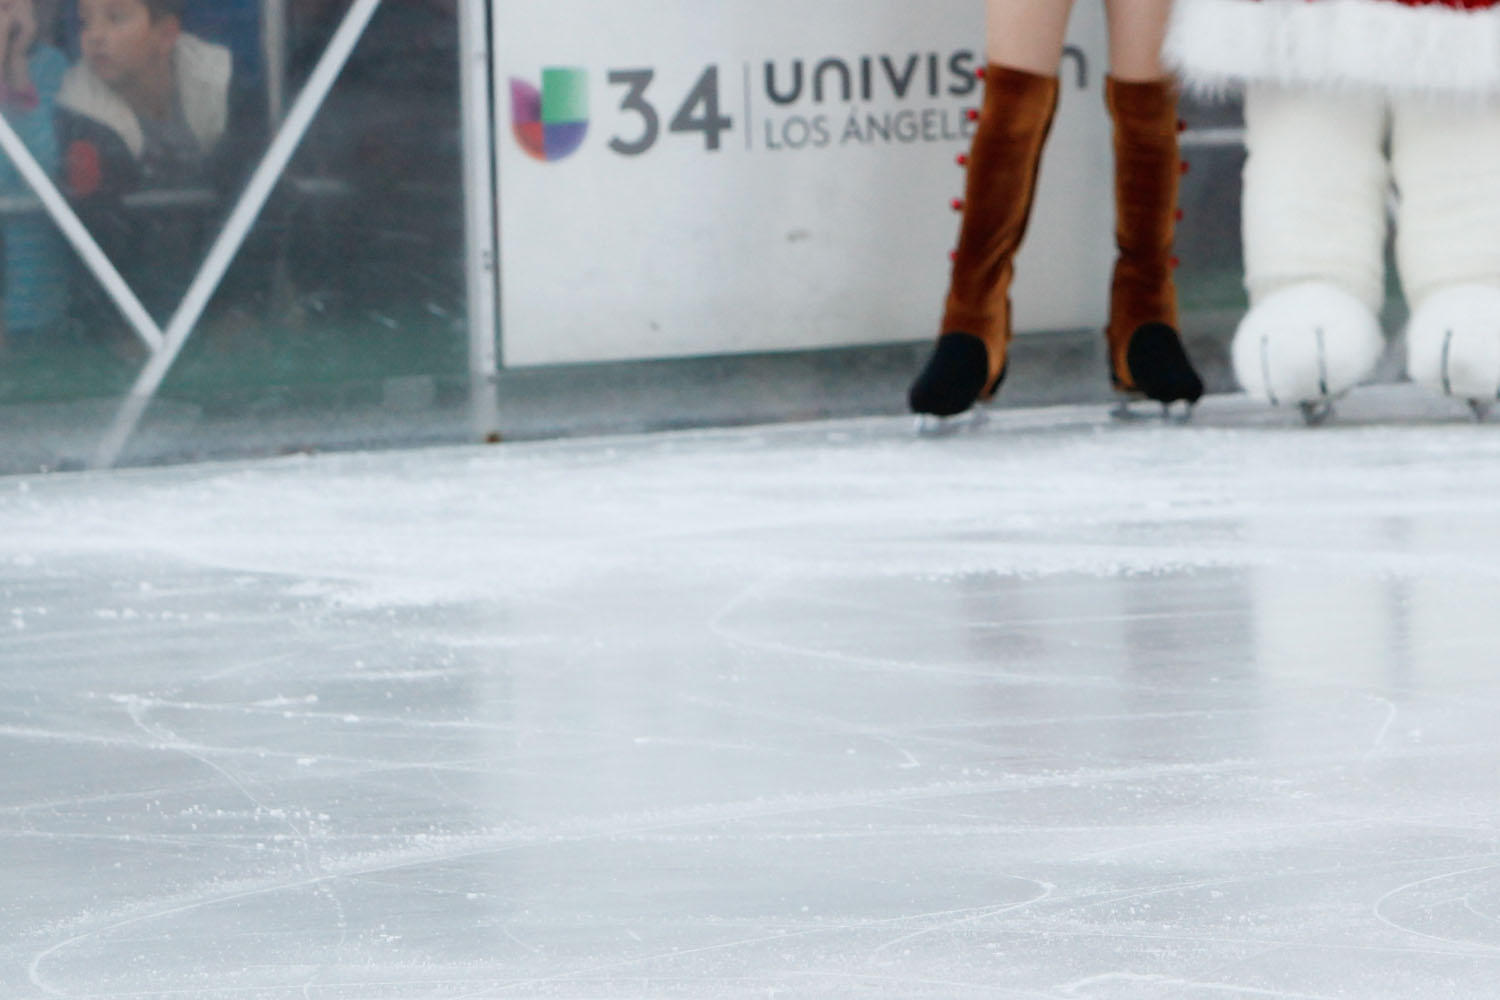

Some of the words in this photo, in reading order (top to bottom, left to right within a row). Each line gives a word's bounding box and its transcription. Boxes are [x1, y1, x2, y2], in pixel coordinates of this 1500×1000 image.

[763, 44, 1088, 105] UNIVISN
[606, 64, 733, 156] 34
[764, 115, 831, 150] LOS
[840, 106, 977, 146] ÁNGELE
